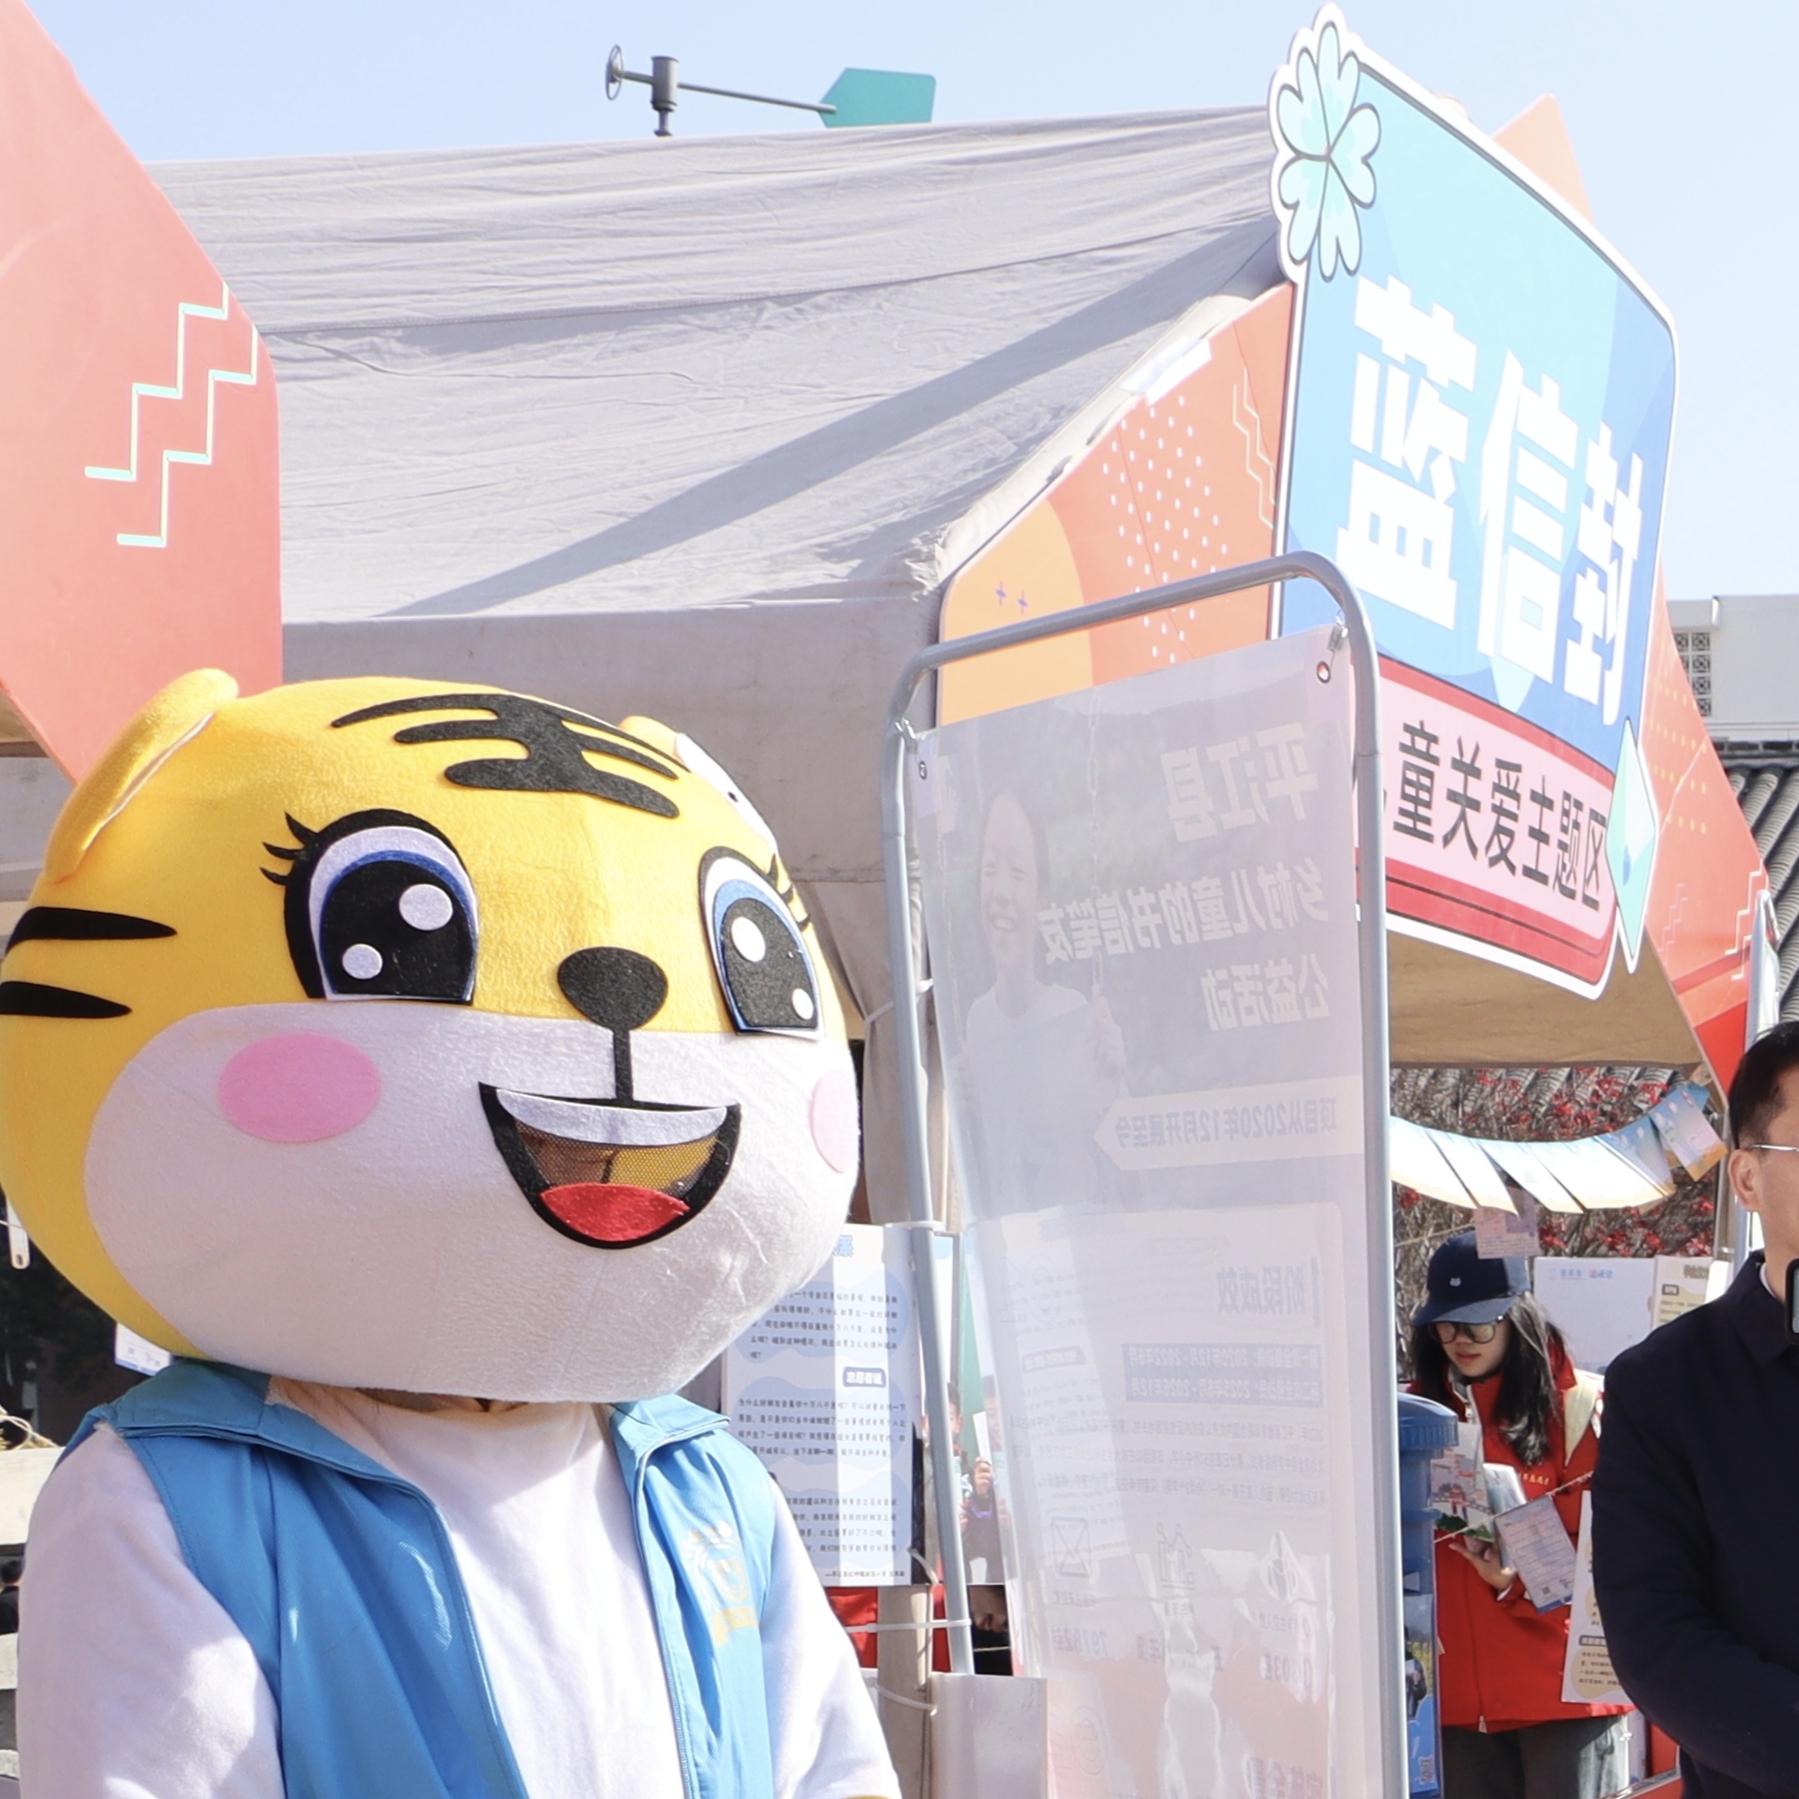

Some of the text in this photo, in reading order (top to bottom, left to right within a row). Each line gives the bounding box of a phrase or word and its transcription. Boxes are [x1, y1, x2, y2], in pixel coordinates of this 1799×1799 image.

[1337, 273, 1643, 726] 蓝信封
[1383, 719, 1607, 912] 童关爱主题区
